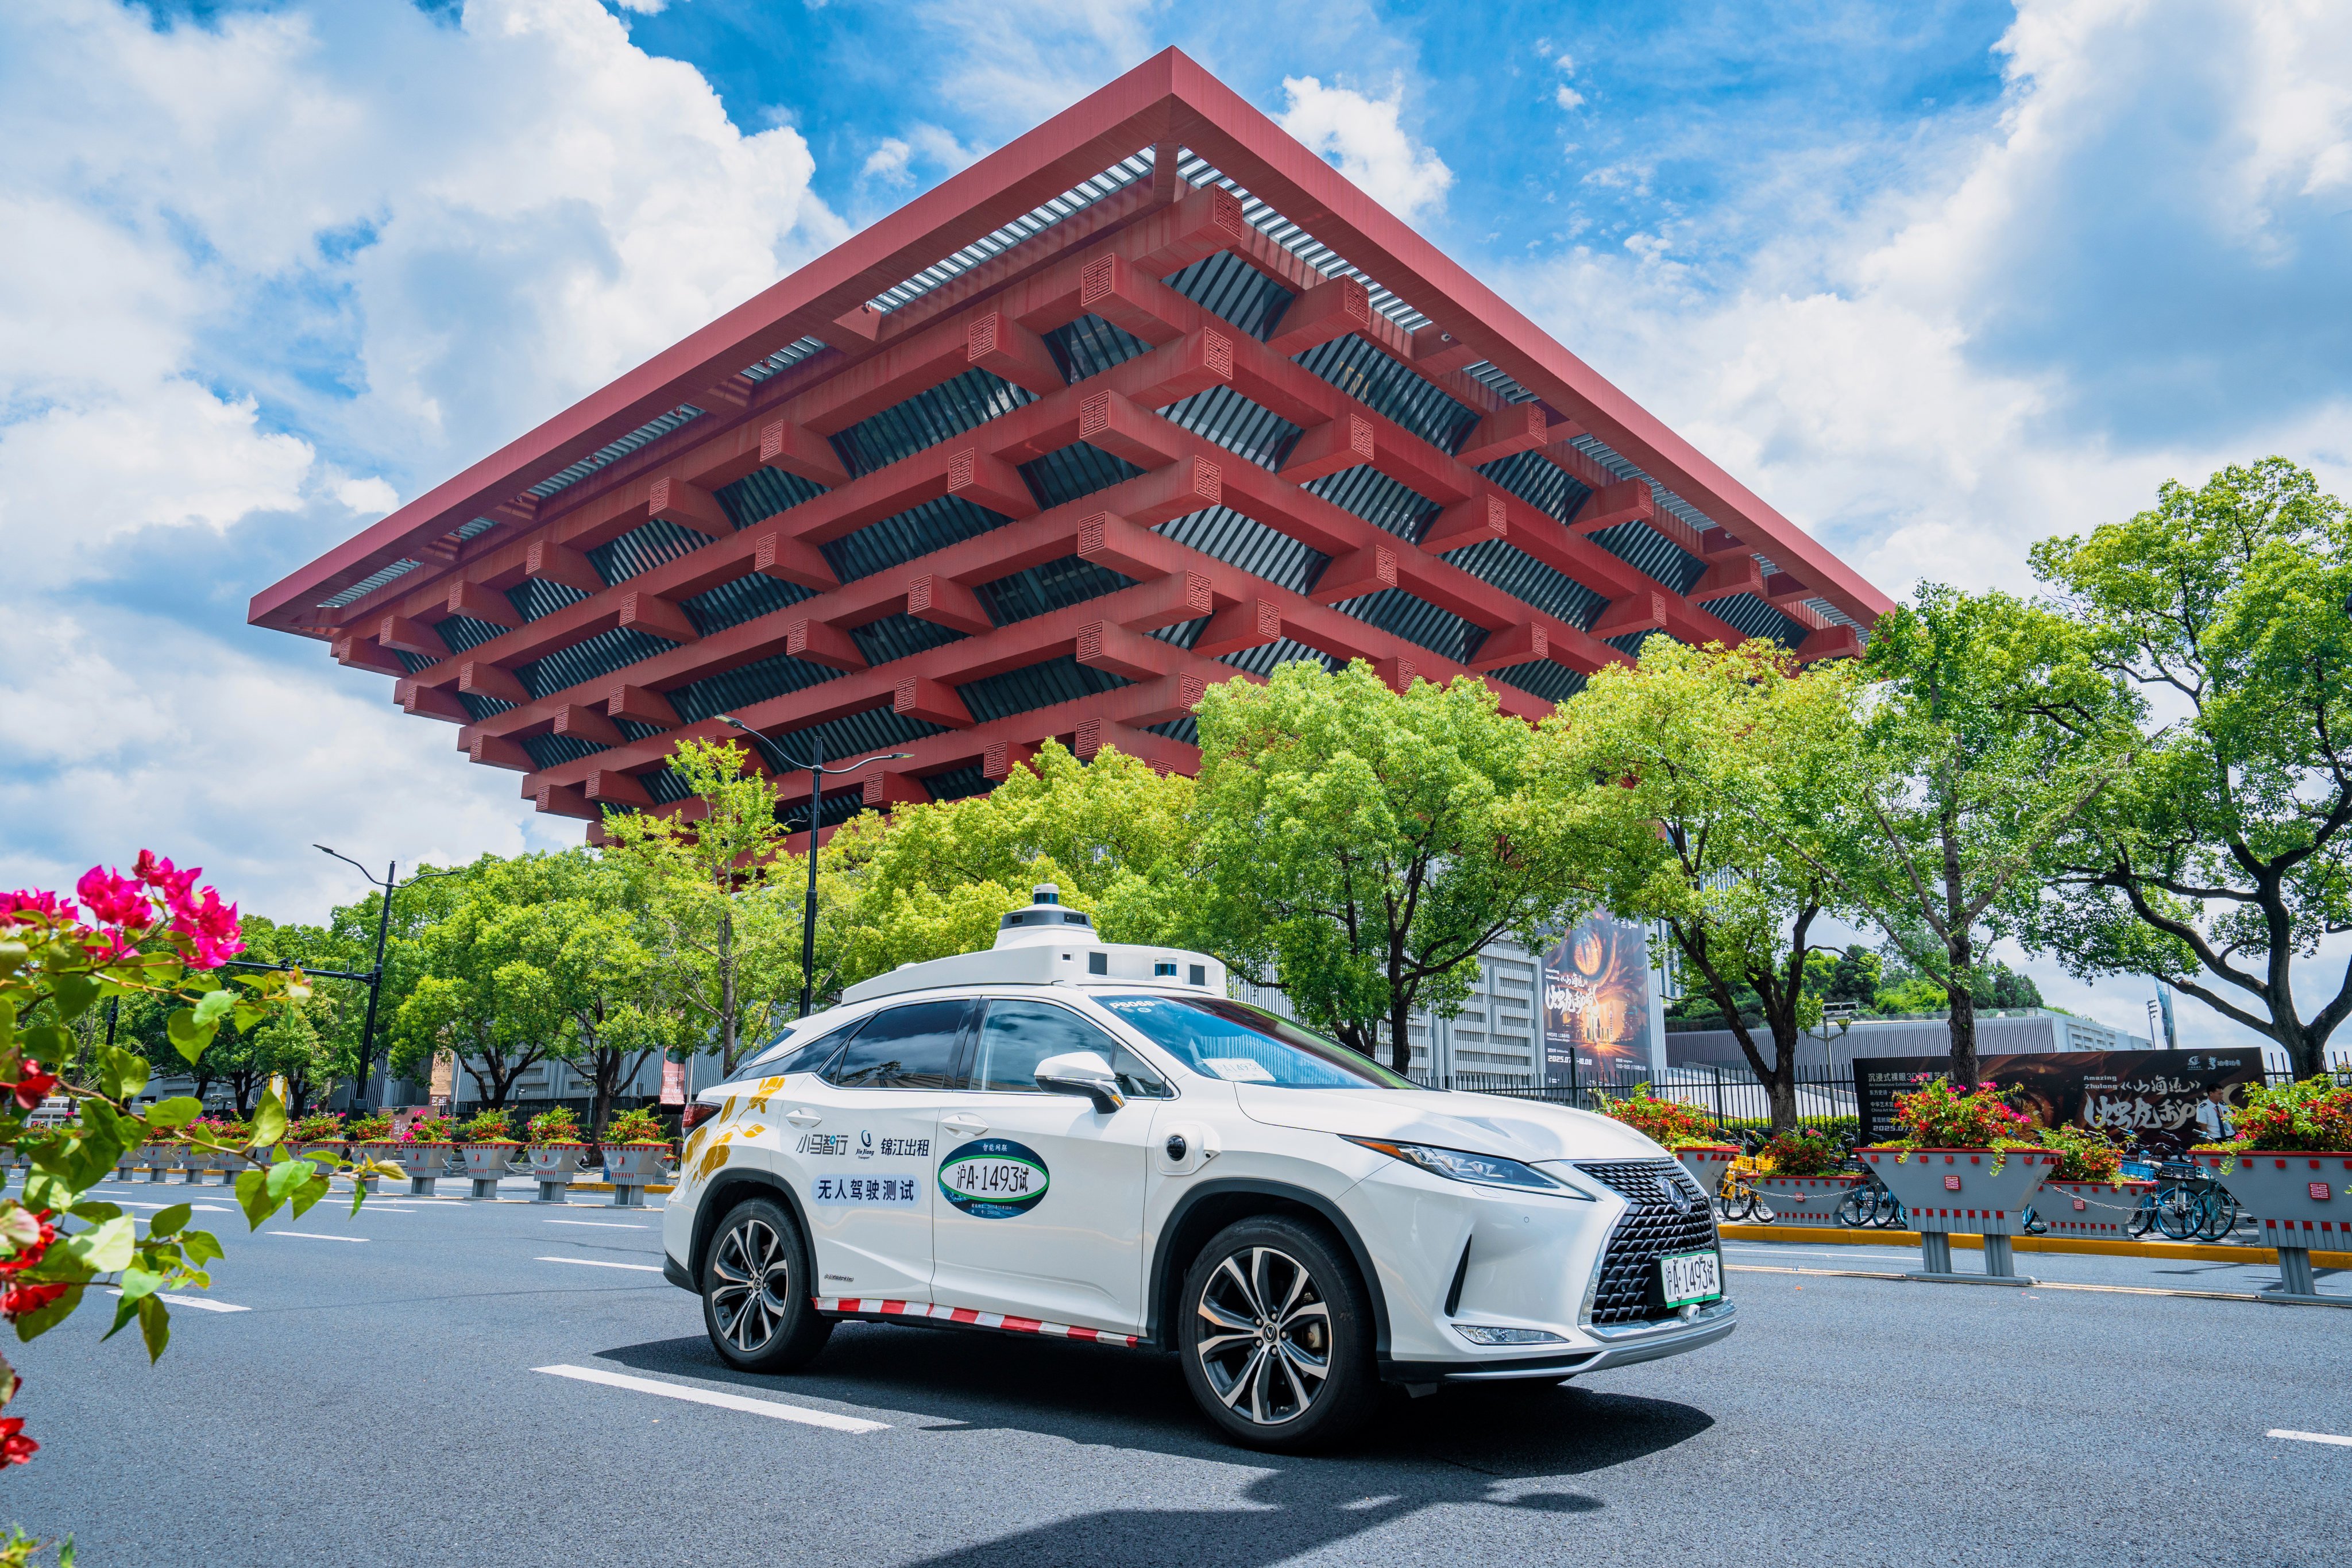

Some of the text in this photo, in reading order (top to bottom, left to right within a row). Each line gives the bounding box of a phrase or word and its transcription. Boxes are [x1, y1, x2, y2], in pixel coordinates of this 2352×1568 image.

[795, 1134, 849, 1156] 小马智行
[880, 1138, 930, 1157] 锦江出租
[983, 1142, 1007, 1152] 智能网联
[817, 1179, 914, 1202] 无人驾驶测试
[824, 1273, 854, 1282] HYBRID
